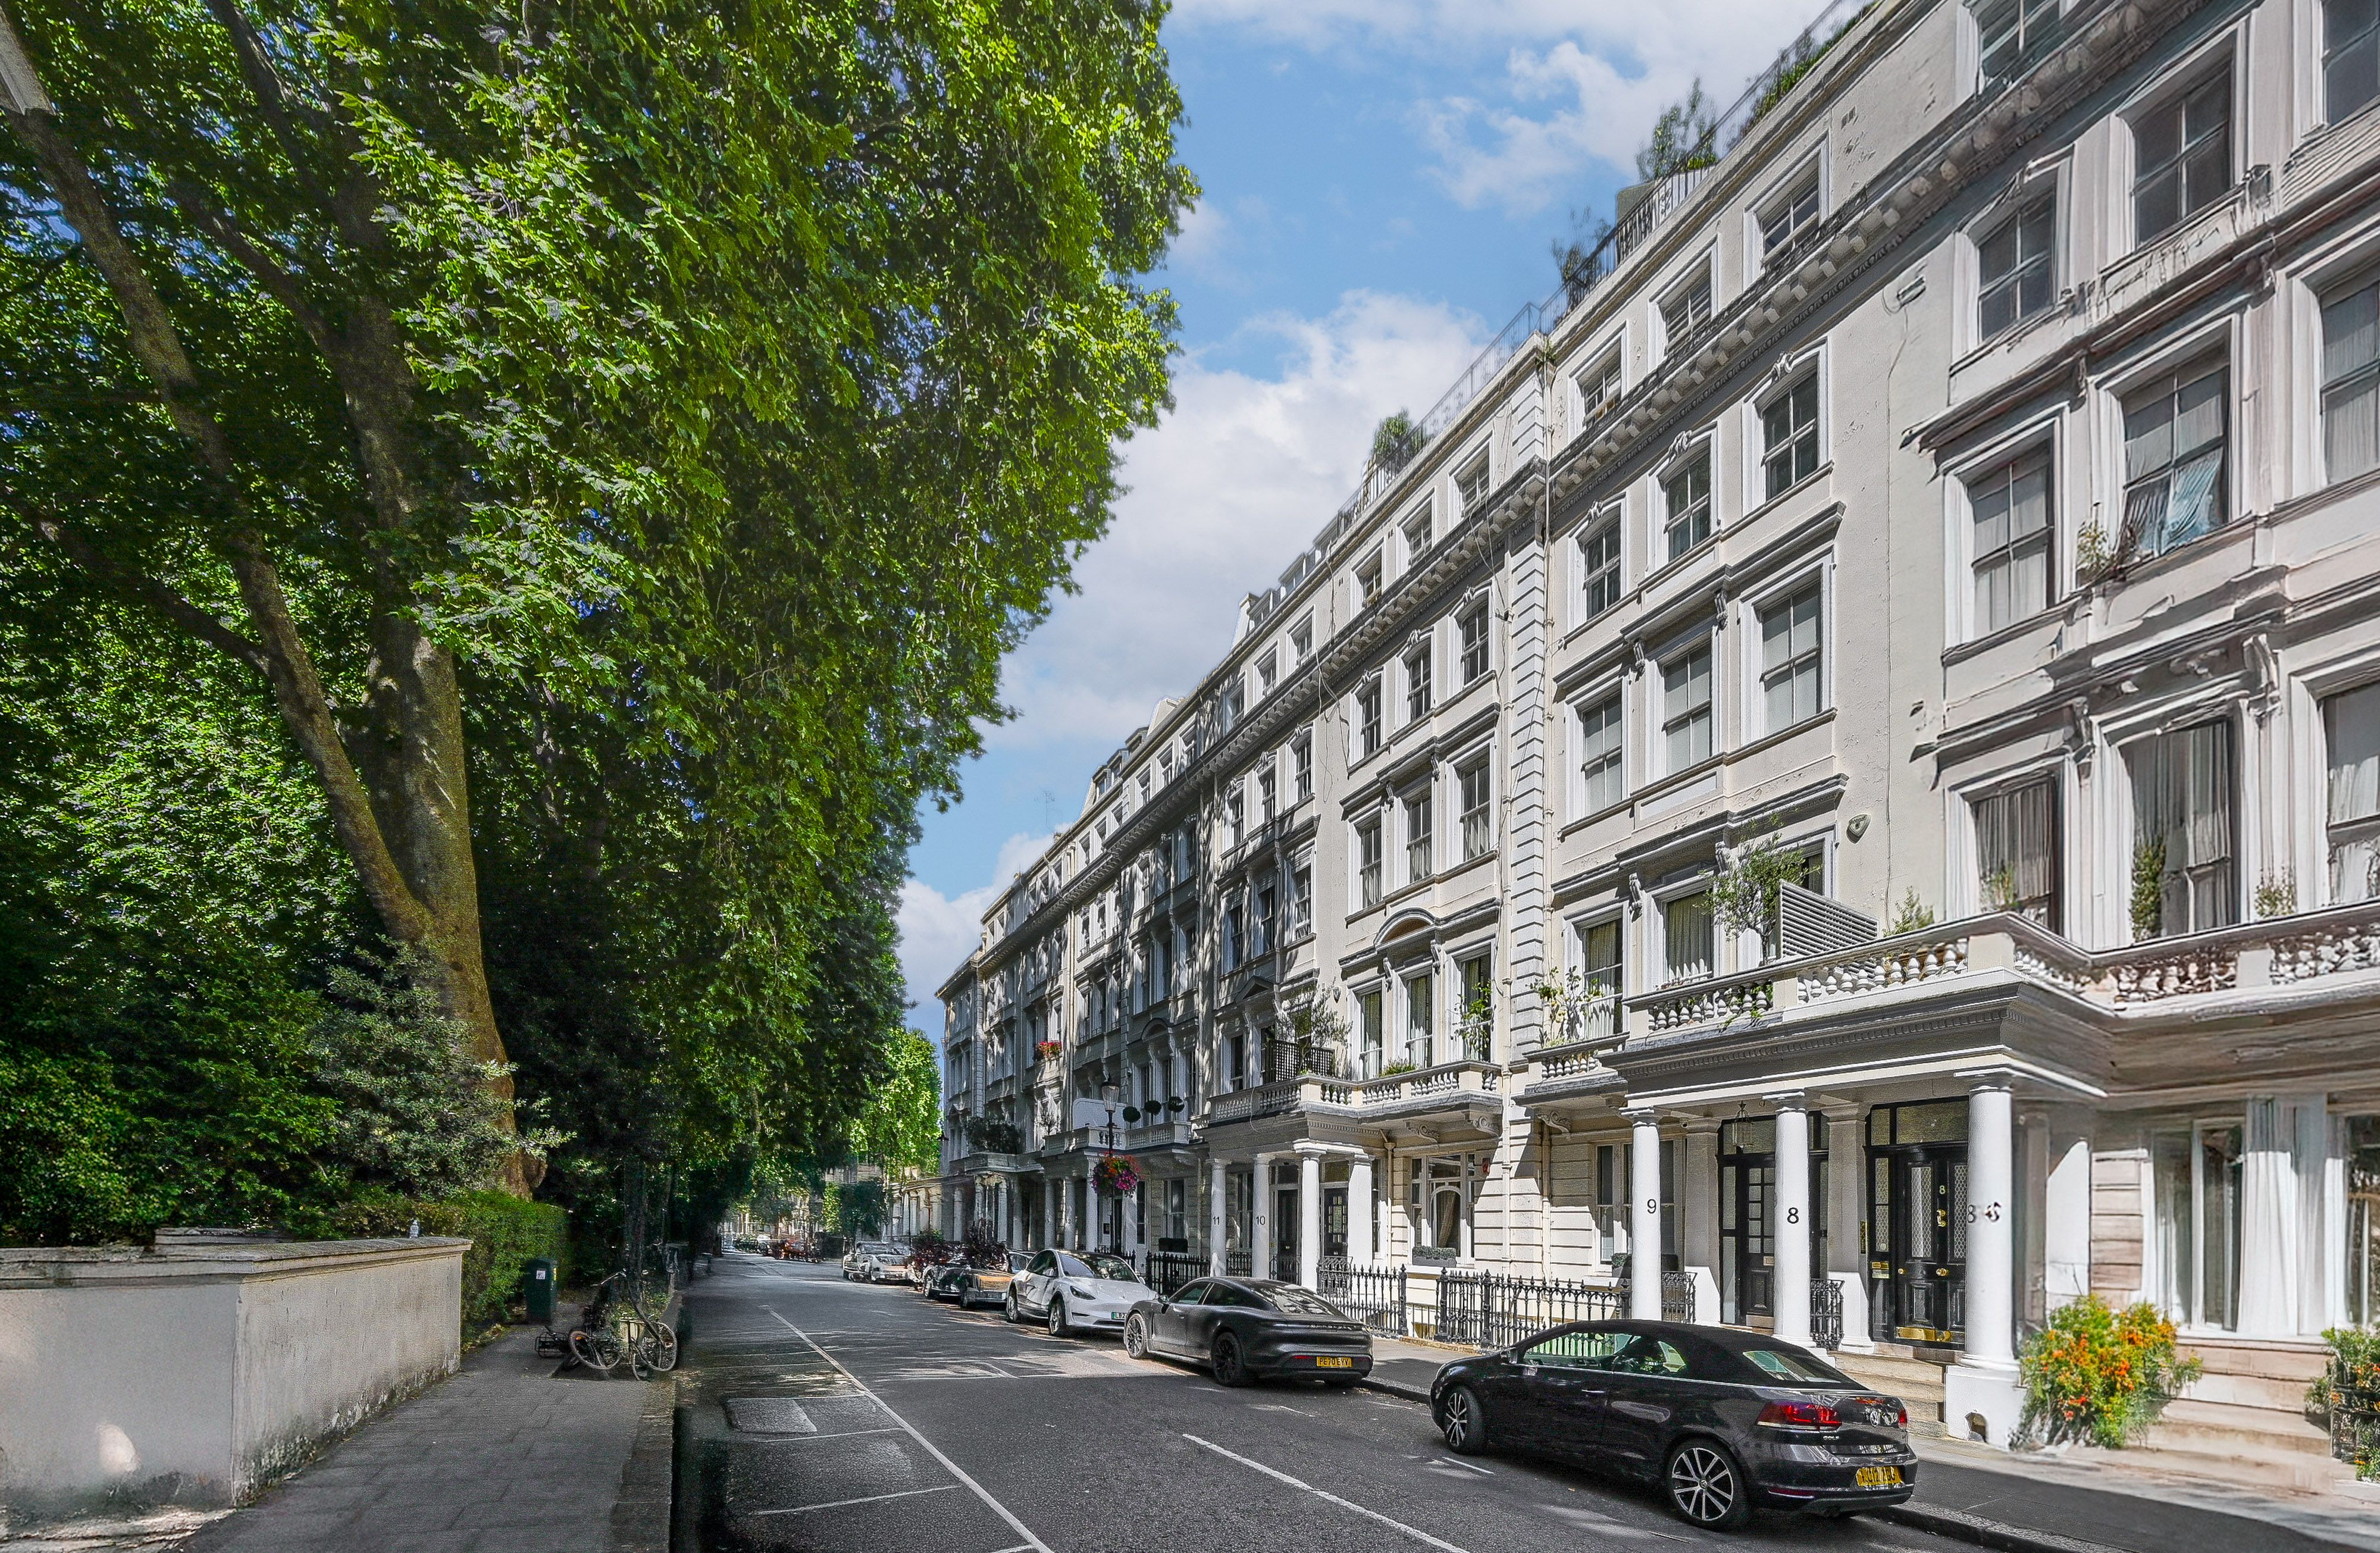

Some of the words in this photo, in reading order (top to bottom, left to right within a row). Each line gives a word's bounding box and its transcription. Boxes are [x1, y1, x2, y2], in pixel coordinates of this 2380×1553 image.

[1940, 1185, 1946, 1194] 8
[1648, 1199, 1656, 1214] 9
[1787, 1207, 1799, 1224] 8
[1213, 1216, 1220, 1225] 11
[1256, 1216, 1266, 1225] 10
